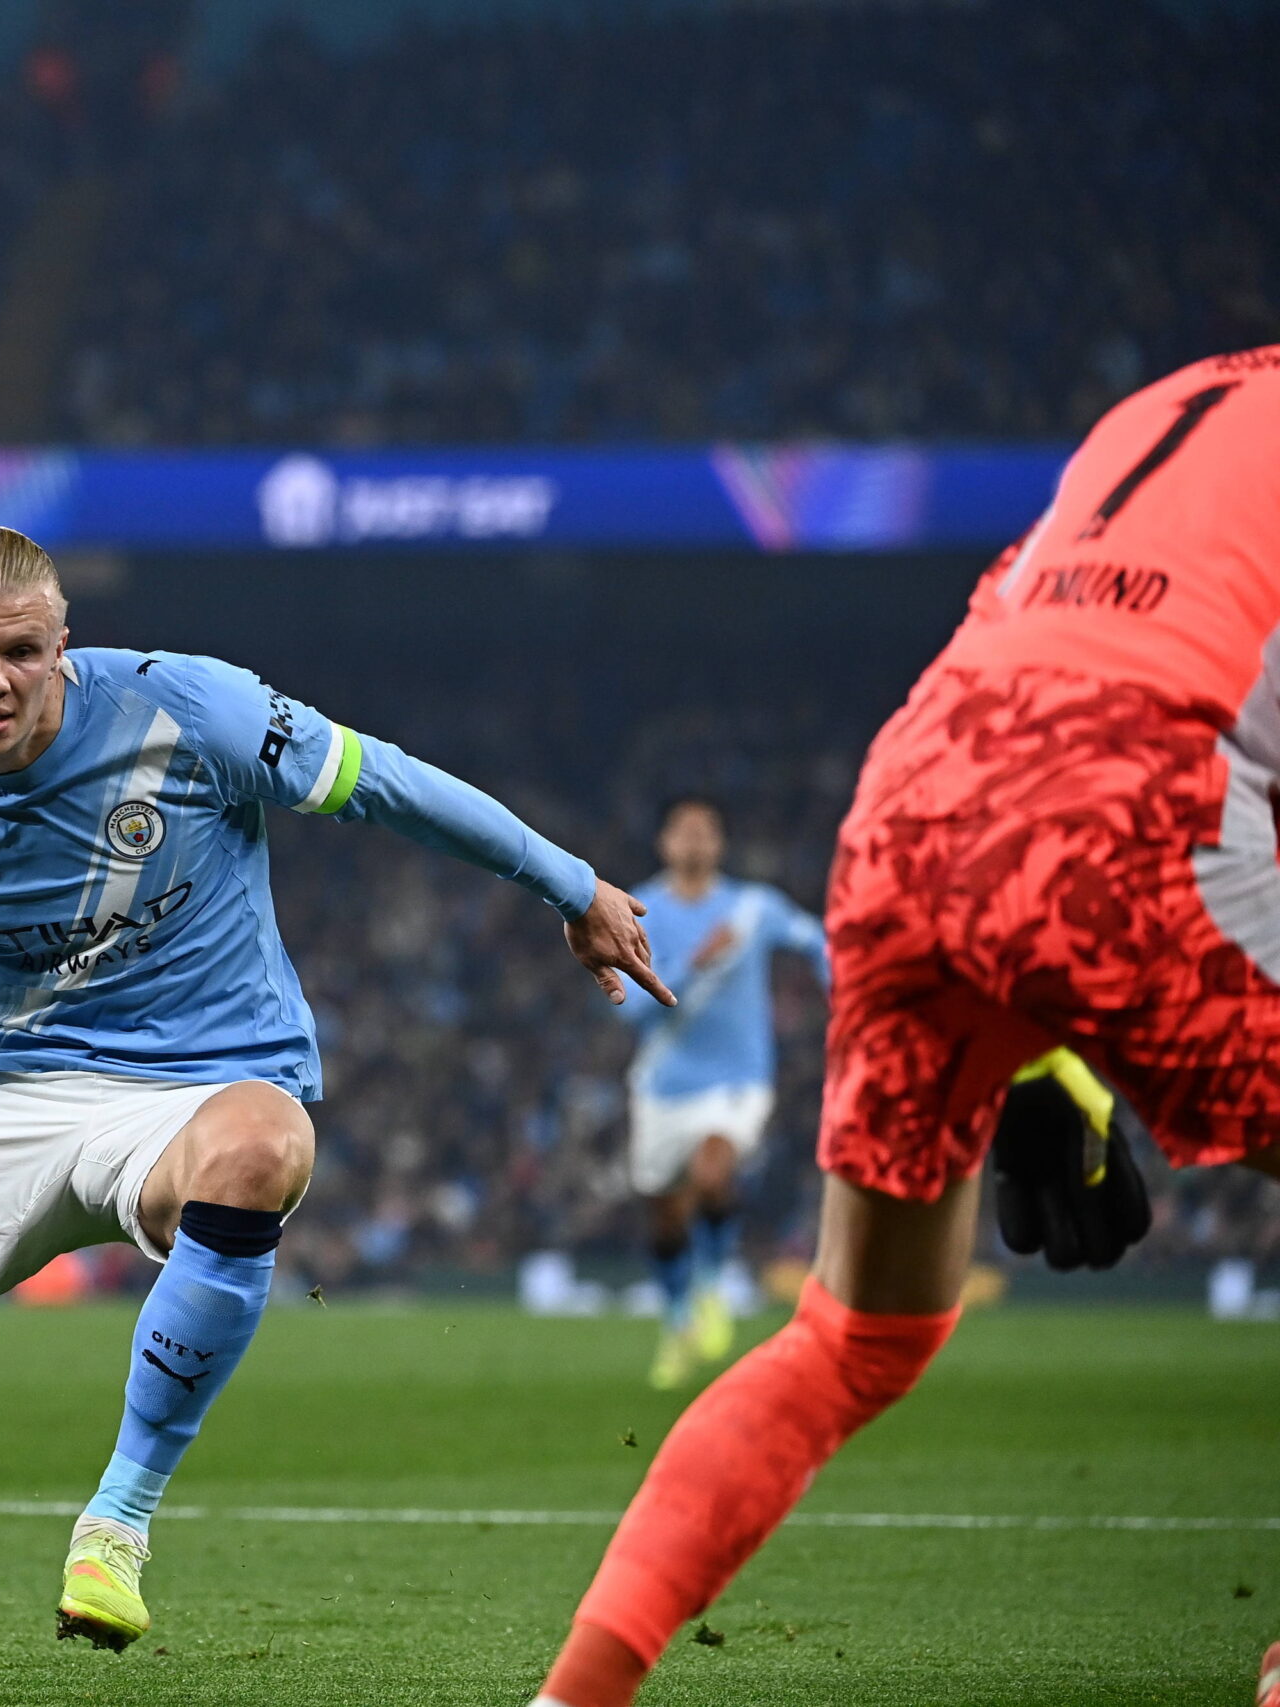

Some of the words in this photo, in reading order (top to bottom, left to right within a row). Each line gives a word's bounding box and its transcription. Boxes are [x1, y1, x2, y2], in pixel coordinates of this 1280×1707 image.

[1077, 380, 1242, 540] 1
[110, 804, 155, 830] MANCHESTER
[135, 844, 153, 855] CITY
[20, 934, 152, 975] AIRWAYS
[151, 1330, 215, 1362] CITY
